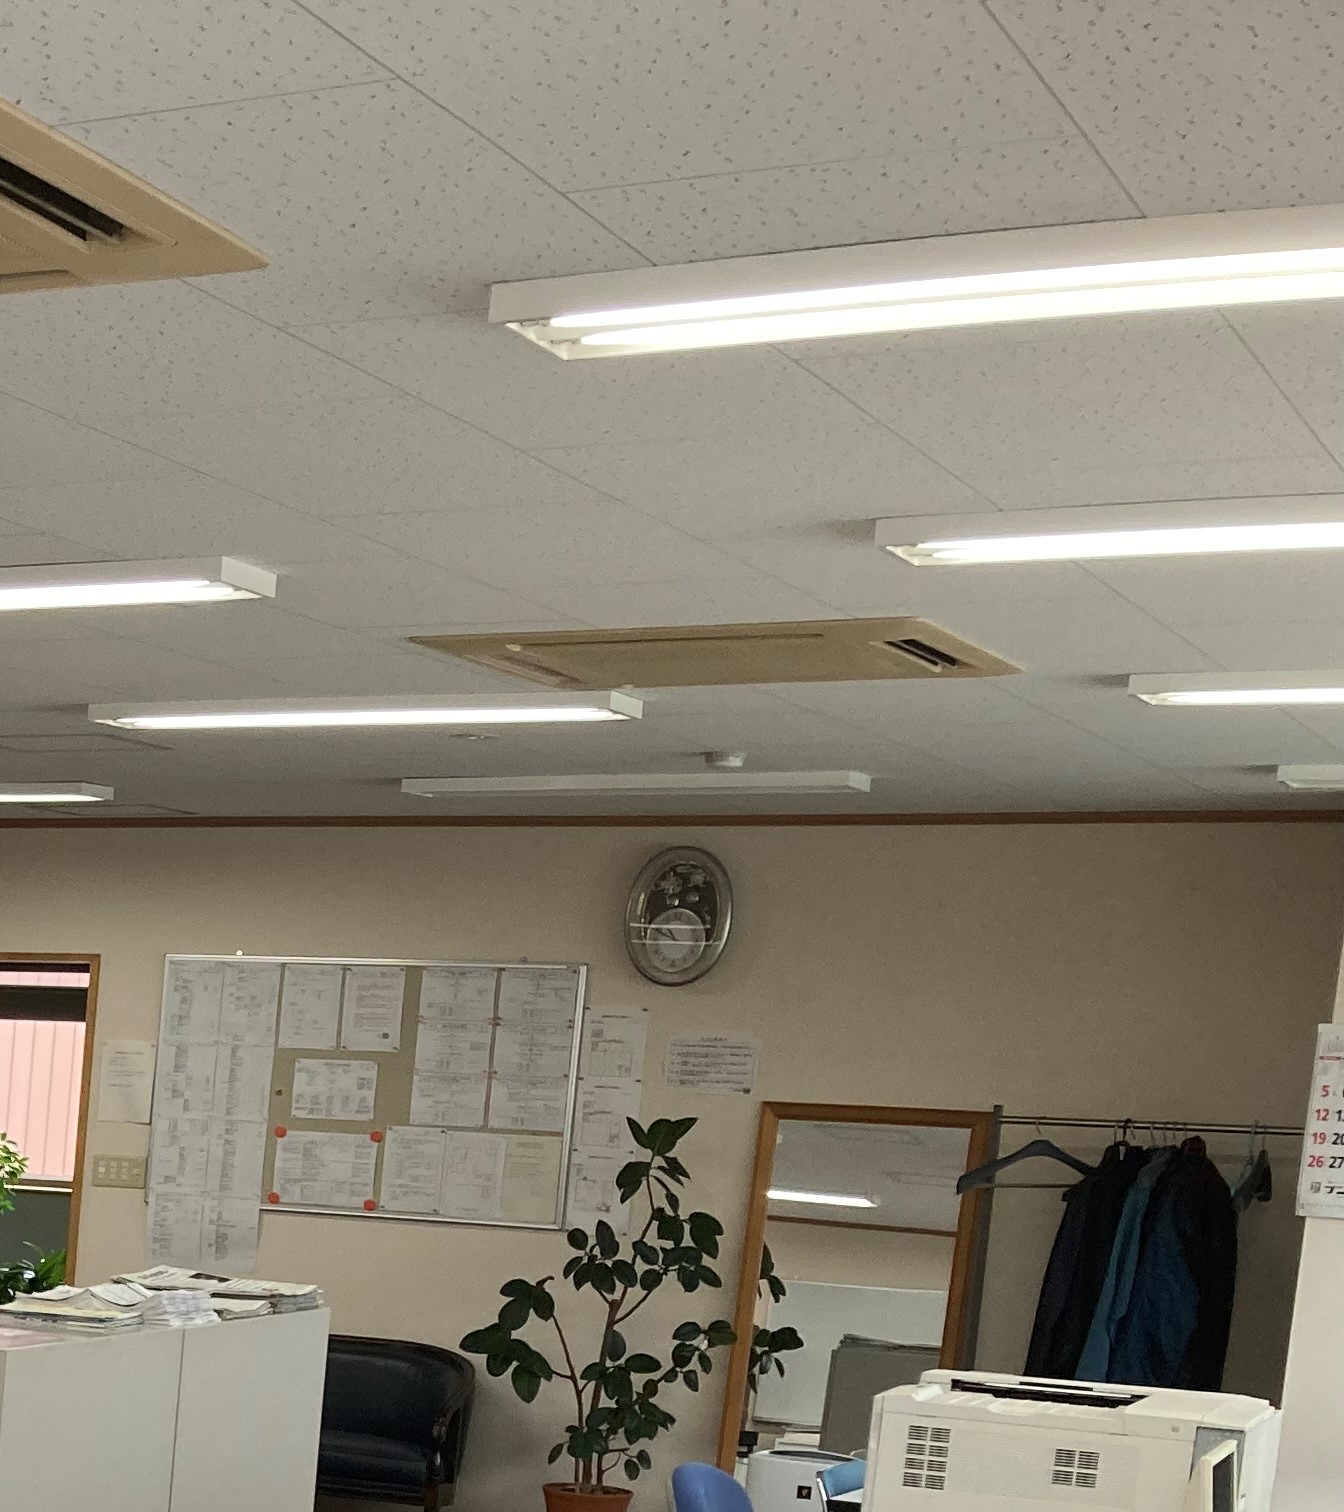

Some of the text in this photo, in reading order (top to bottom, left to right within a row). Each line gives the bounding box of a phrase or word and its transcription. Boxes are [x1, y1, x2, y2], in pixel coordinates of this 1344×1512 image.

[1321, 1085, 1330, 1097] 5
[1315, 1108, 1329, 1121] 12
[1311, 1131, 1327, 1144] 19
[1307, 1155, 1344, 1169] 26 27
